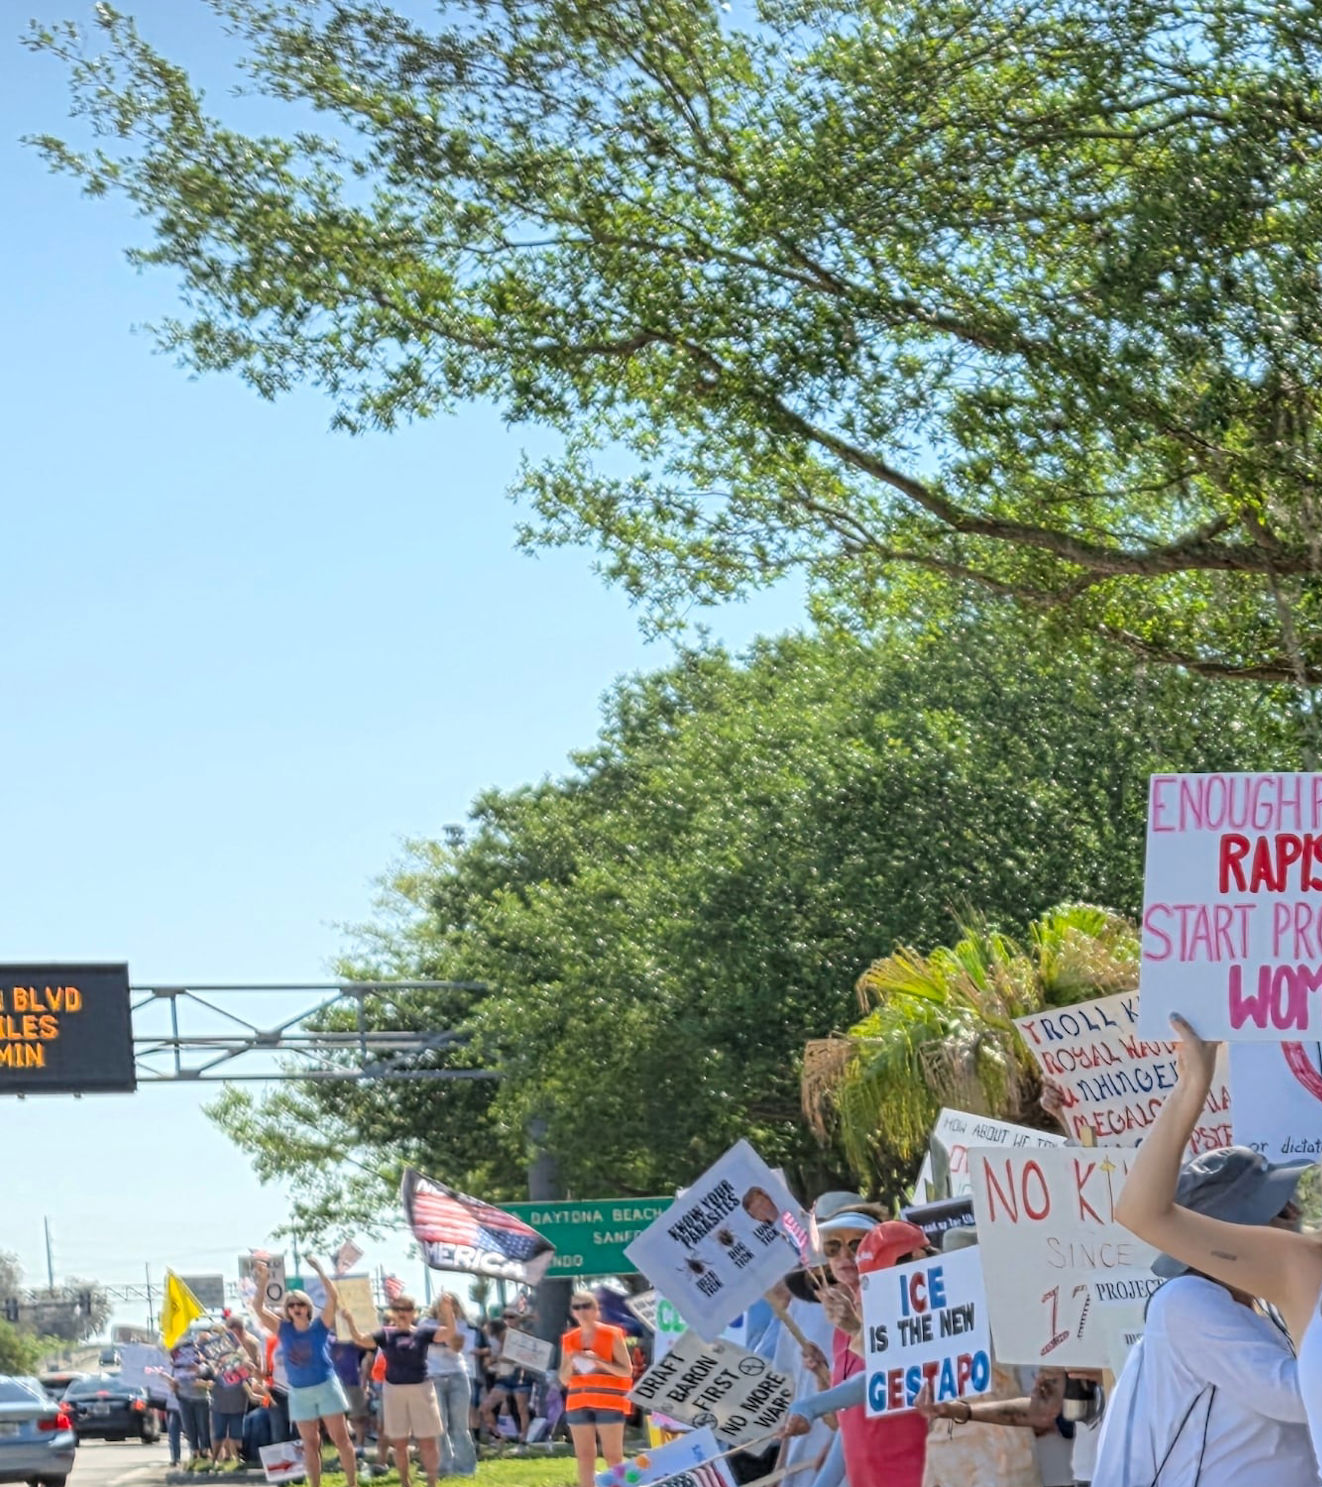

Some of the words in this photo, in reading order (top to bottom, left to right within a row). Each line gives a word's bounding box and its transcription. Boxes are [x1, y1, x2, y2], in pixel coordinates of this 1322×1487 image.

[1152, 775, 1302, 832] ENOUGH
[1143, 903, 1256, 962] START
[13, 986, 83, 1012] BLVD
[1042, 1043, 1122, 1076] ROYAL
[667, 1205, 704, 1241] KNOW
[700, 1180, 734, 1209] YOUR
[983, 1156, 1050, 1224] NO
[530, 1210, 606, 1226] DAYTONA
[612, 1207, 664, 1222] BEACH
[1047, 1237, 1133, 1270] SINCE
[899, 1265, 947, 1316] ICE
[869, 1325, 889, 1353] IS
[897, 1314, 934, 1347] THE
[939, 1302, 975, 1338] NEW
[635, 1350, 685, 1400] DRAFT
[666, 1354, 719, 1403] BARON
[692, 1368, 741, 1412] FIRST
[868, 1350, 990, 1412] GESTAPO
[719, 1415, 749, 1437] NO
[740, 1371, 786, 1414] MORE
